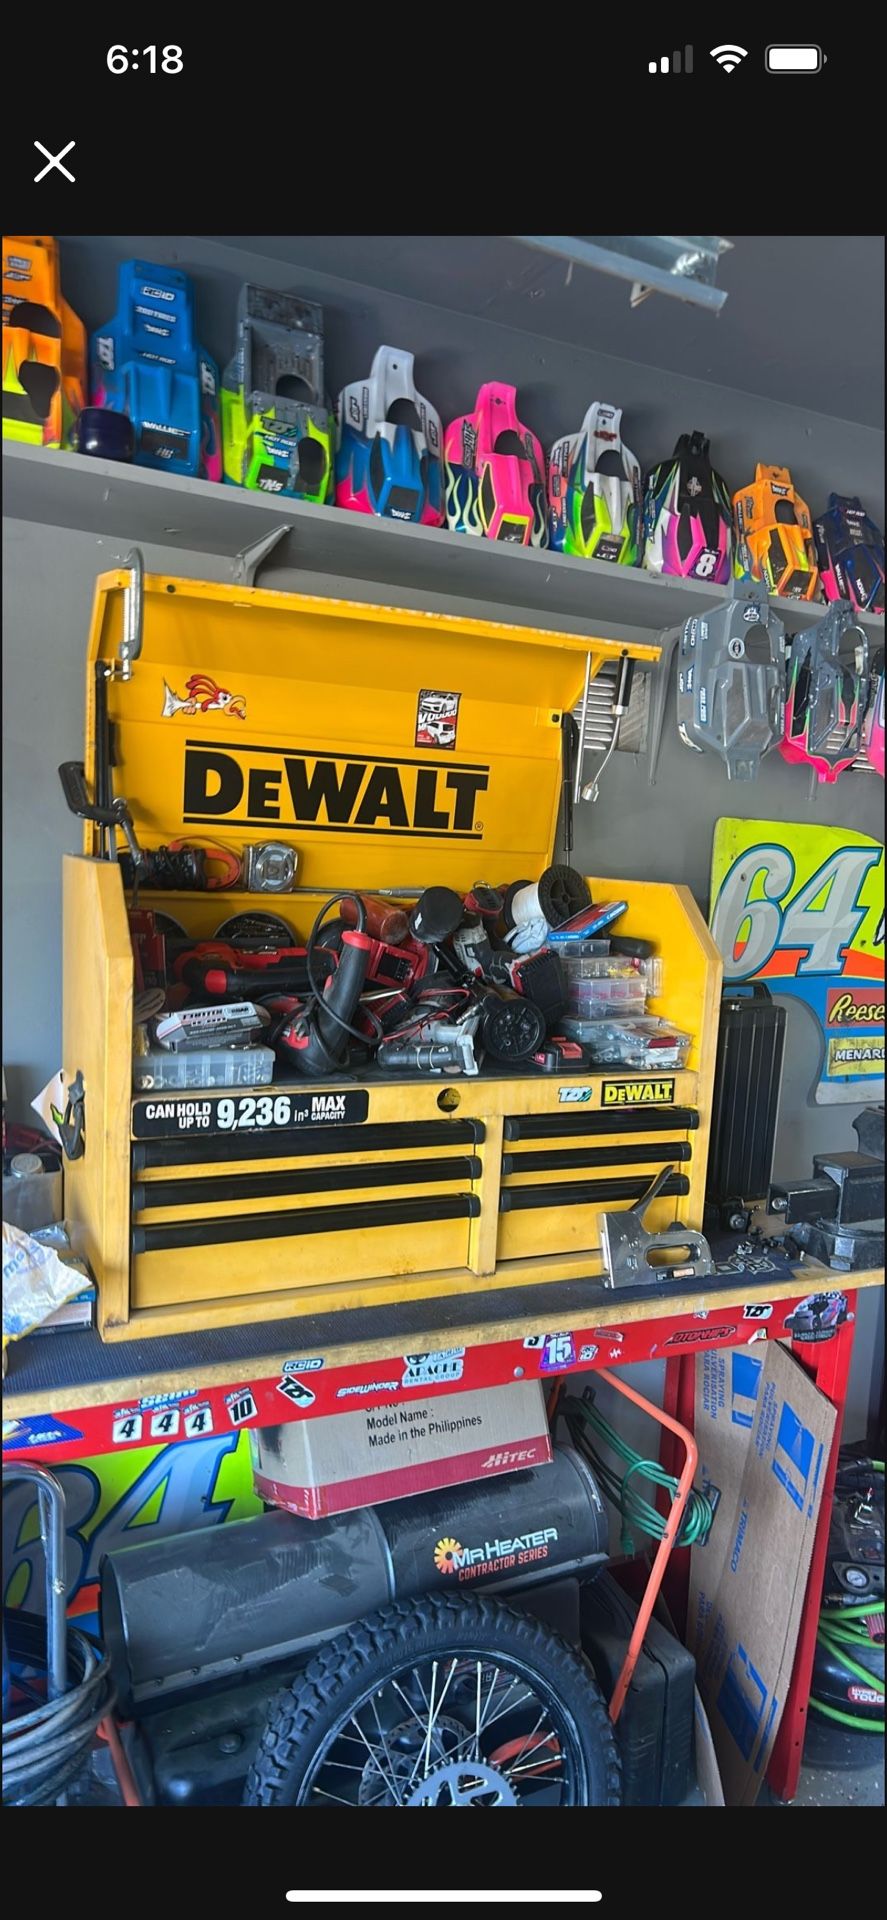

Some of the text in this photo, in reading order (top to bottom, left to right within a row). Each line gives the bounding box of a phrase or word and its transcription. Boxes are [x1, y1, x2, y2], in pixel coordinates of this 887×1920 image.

[695, 553, 716, 577] 8
[711, 842, 884, 982] 64
[145, 1102, 212, 1120] CAN HOLD
[217, 1096, 291, 1131] 9,236
[311, 1095, 346, 1112] MAX
[178, 1115, 210, 1129] UP TO
[311, 1110, 346, 1121] CAPACITY
[545, 1336, 572, 1364] 15
[336, 1382, 399, 1398] SIDEWINDER
[192, 1412, 206, 1432] 4
[231, 1399, 252, 1423] 10
[366, 1412, 398, 1431] Model
[399, 1408, 428, 1424] Name
[120, 1419, 135, 1439] 4
[158, 1413, 173, 1433] 4
[368, 1415, 483, 1448] Made in the Philippines
[485, 1527, 559, 1560] HEATER
[458, 1545, 549, 1582] CONTRACTOR SERIES
